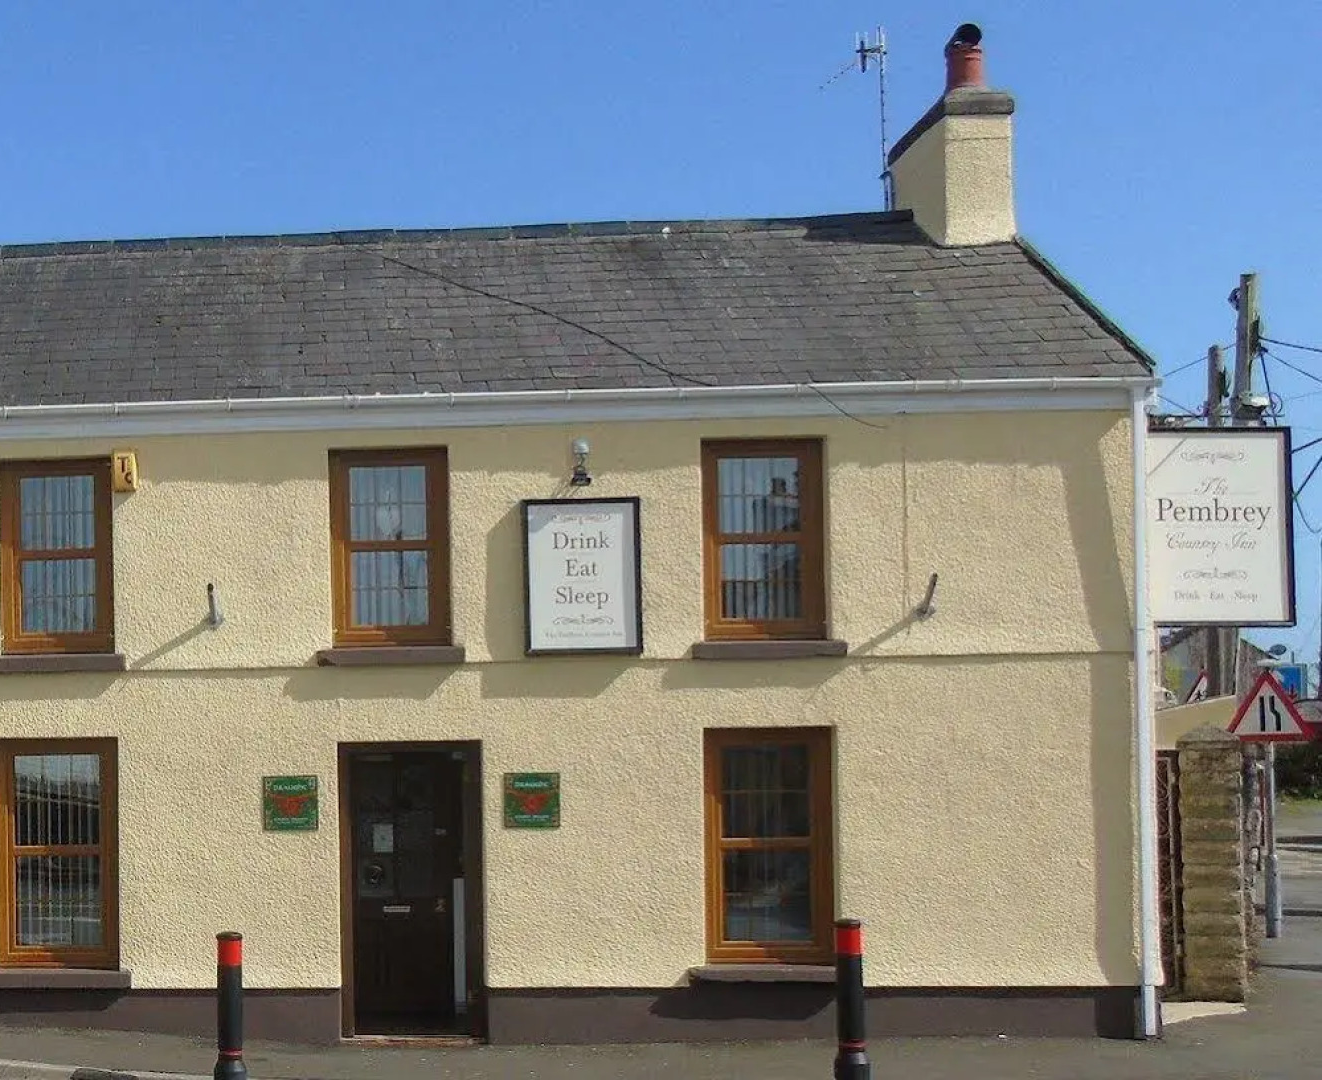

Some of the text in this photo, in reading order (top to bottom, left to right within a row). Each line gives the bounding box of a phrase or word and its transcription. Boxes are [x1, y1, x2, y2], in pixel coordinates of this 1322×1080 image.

[1155, 498, 1271, 530] Pembrey
[552, 531, 610, 550] Drink
[565, 559, 598, 577] Eat
[555, 586, 610, 610] Sleep
